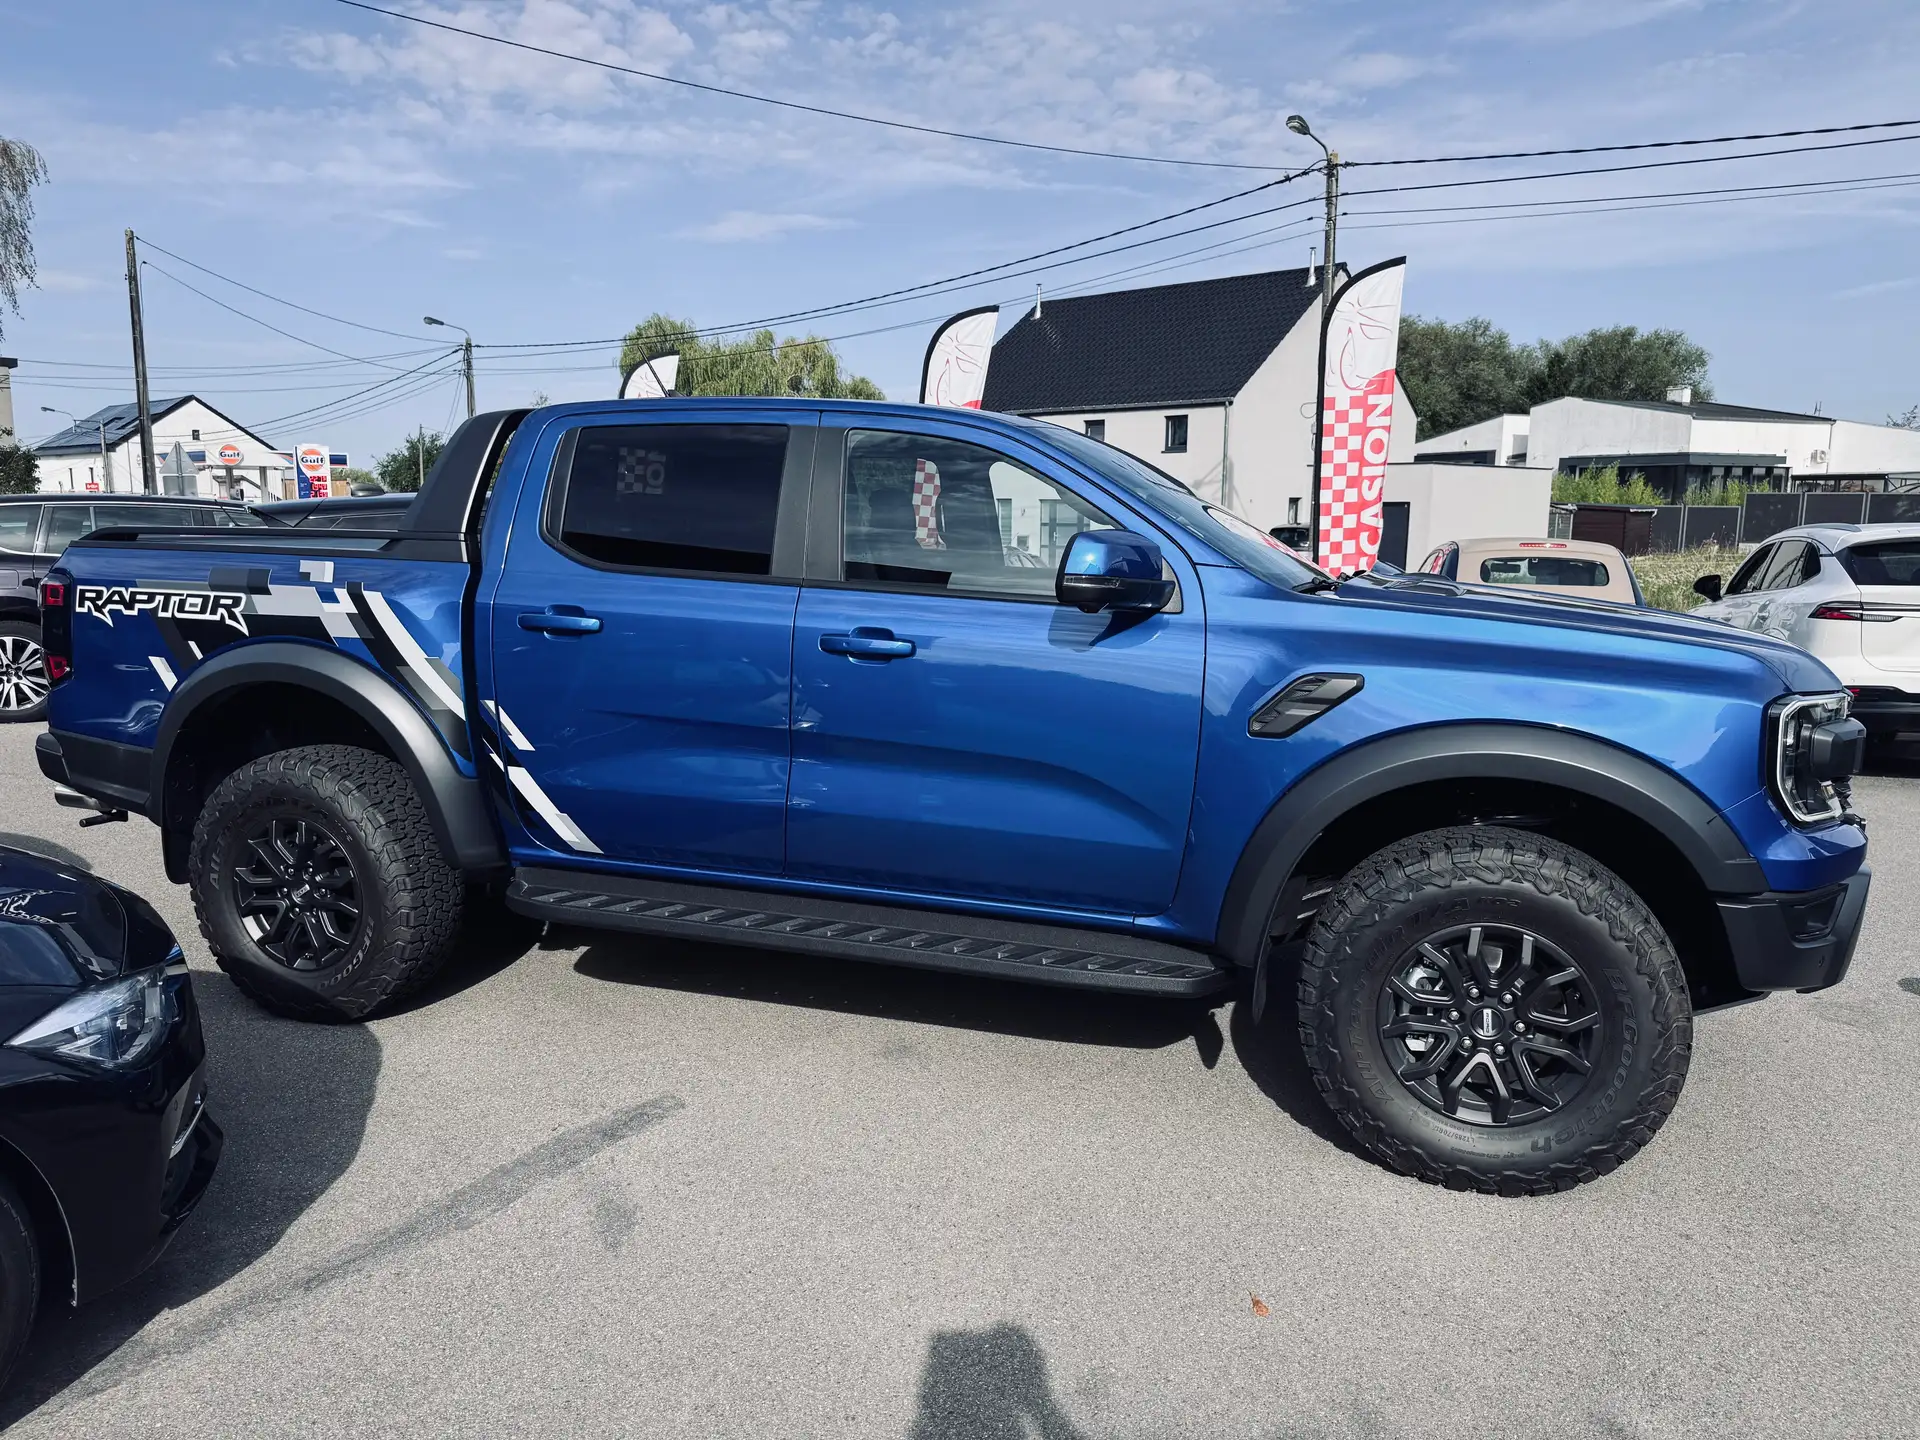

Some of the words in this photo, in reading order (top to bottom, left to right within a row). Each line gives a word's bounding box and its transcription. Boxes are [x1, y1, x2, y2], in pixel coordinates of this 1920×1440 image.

[219, 450, 241, 459] Gulf
[301, 456, 325, 465] Gulf
[76, 585, 250, 637] RAPTOR
